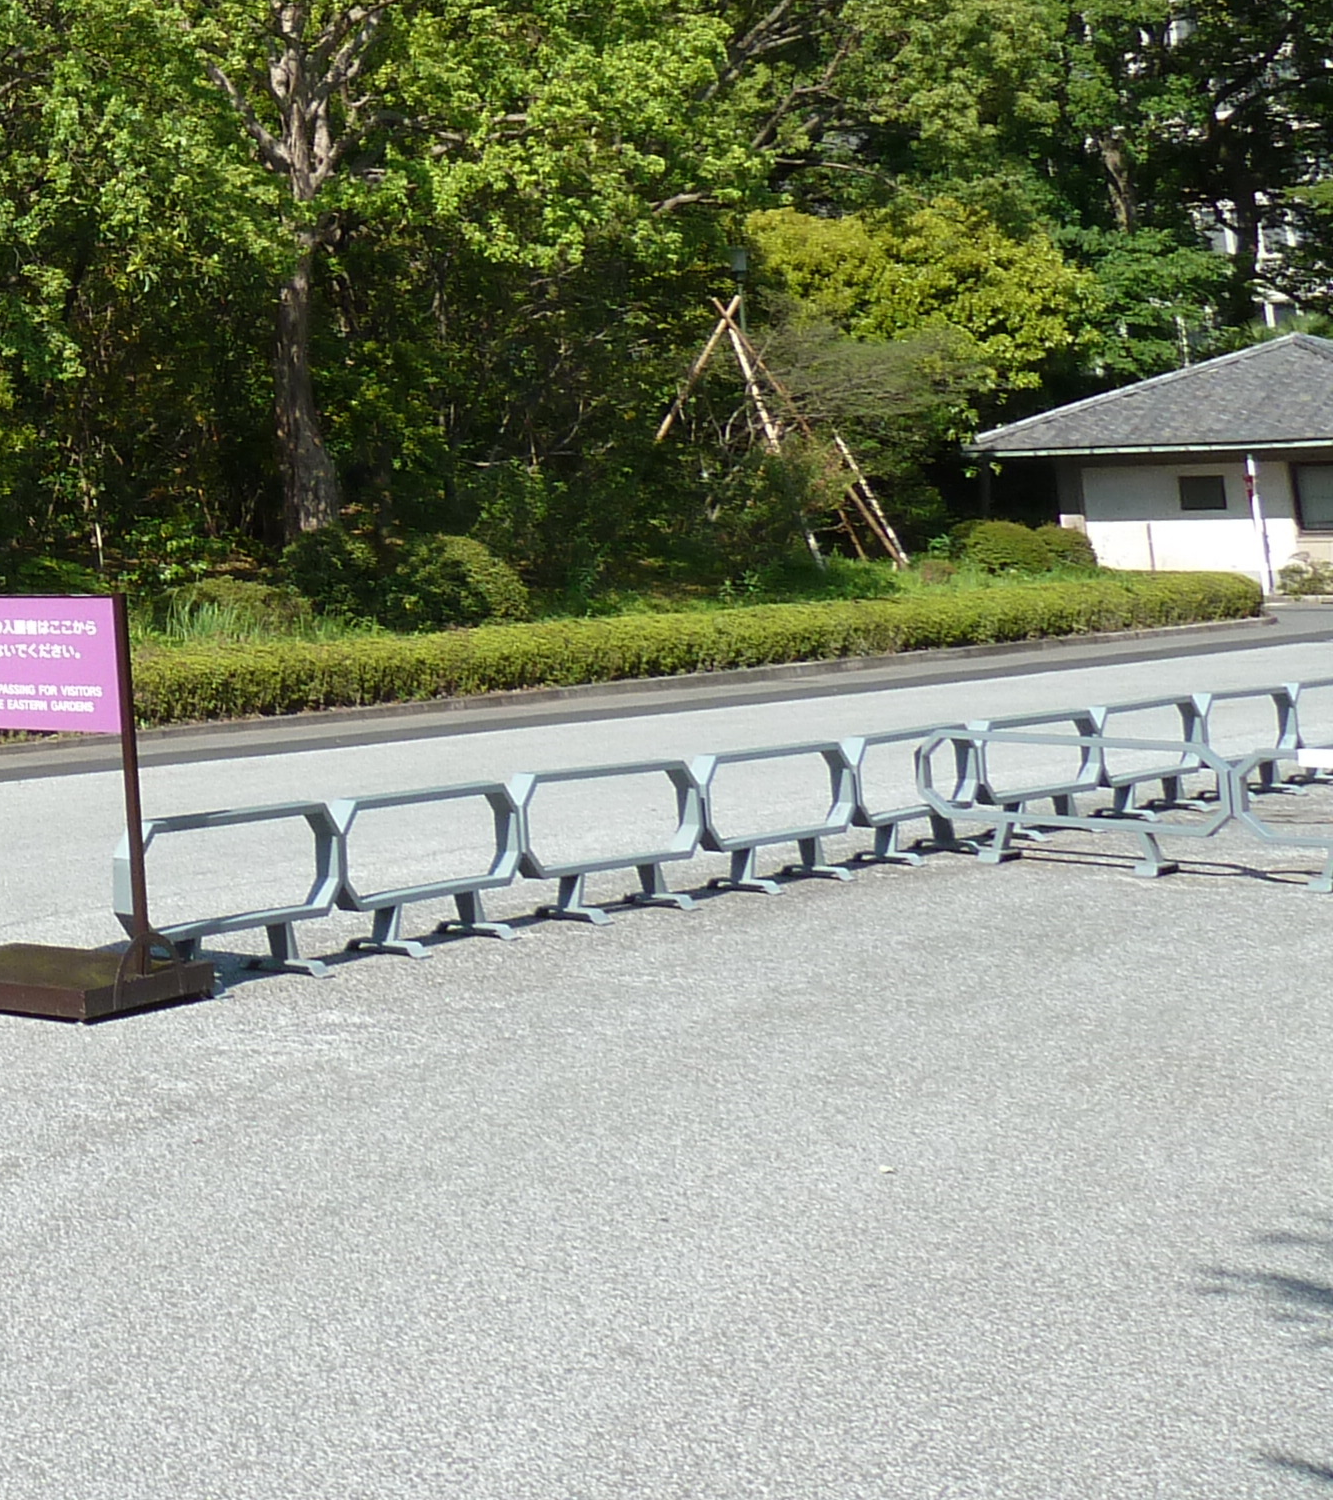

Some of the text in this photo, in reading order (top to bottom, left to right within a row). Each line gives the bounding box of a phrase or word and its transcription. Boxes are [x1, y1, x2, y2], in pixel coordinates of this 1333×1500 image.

[38, 685, 57, 696] FOR
[60, 686, 102, 697] VISITORS
[7, 699, 47, 711] EASTERN
[51, 700, 94, 713] GARDENS
